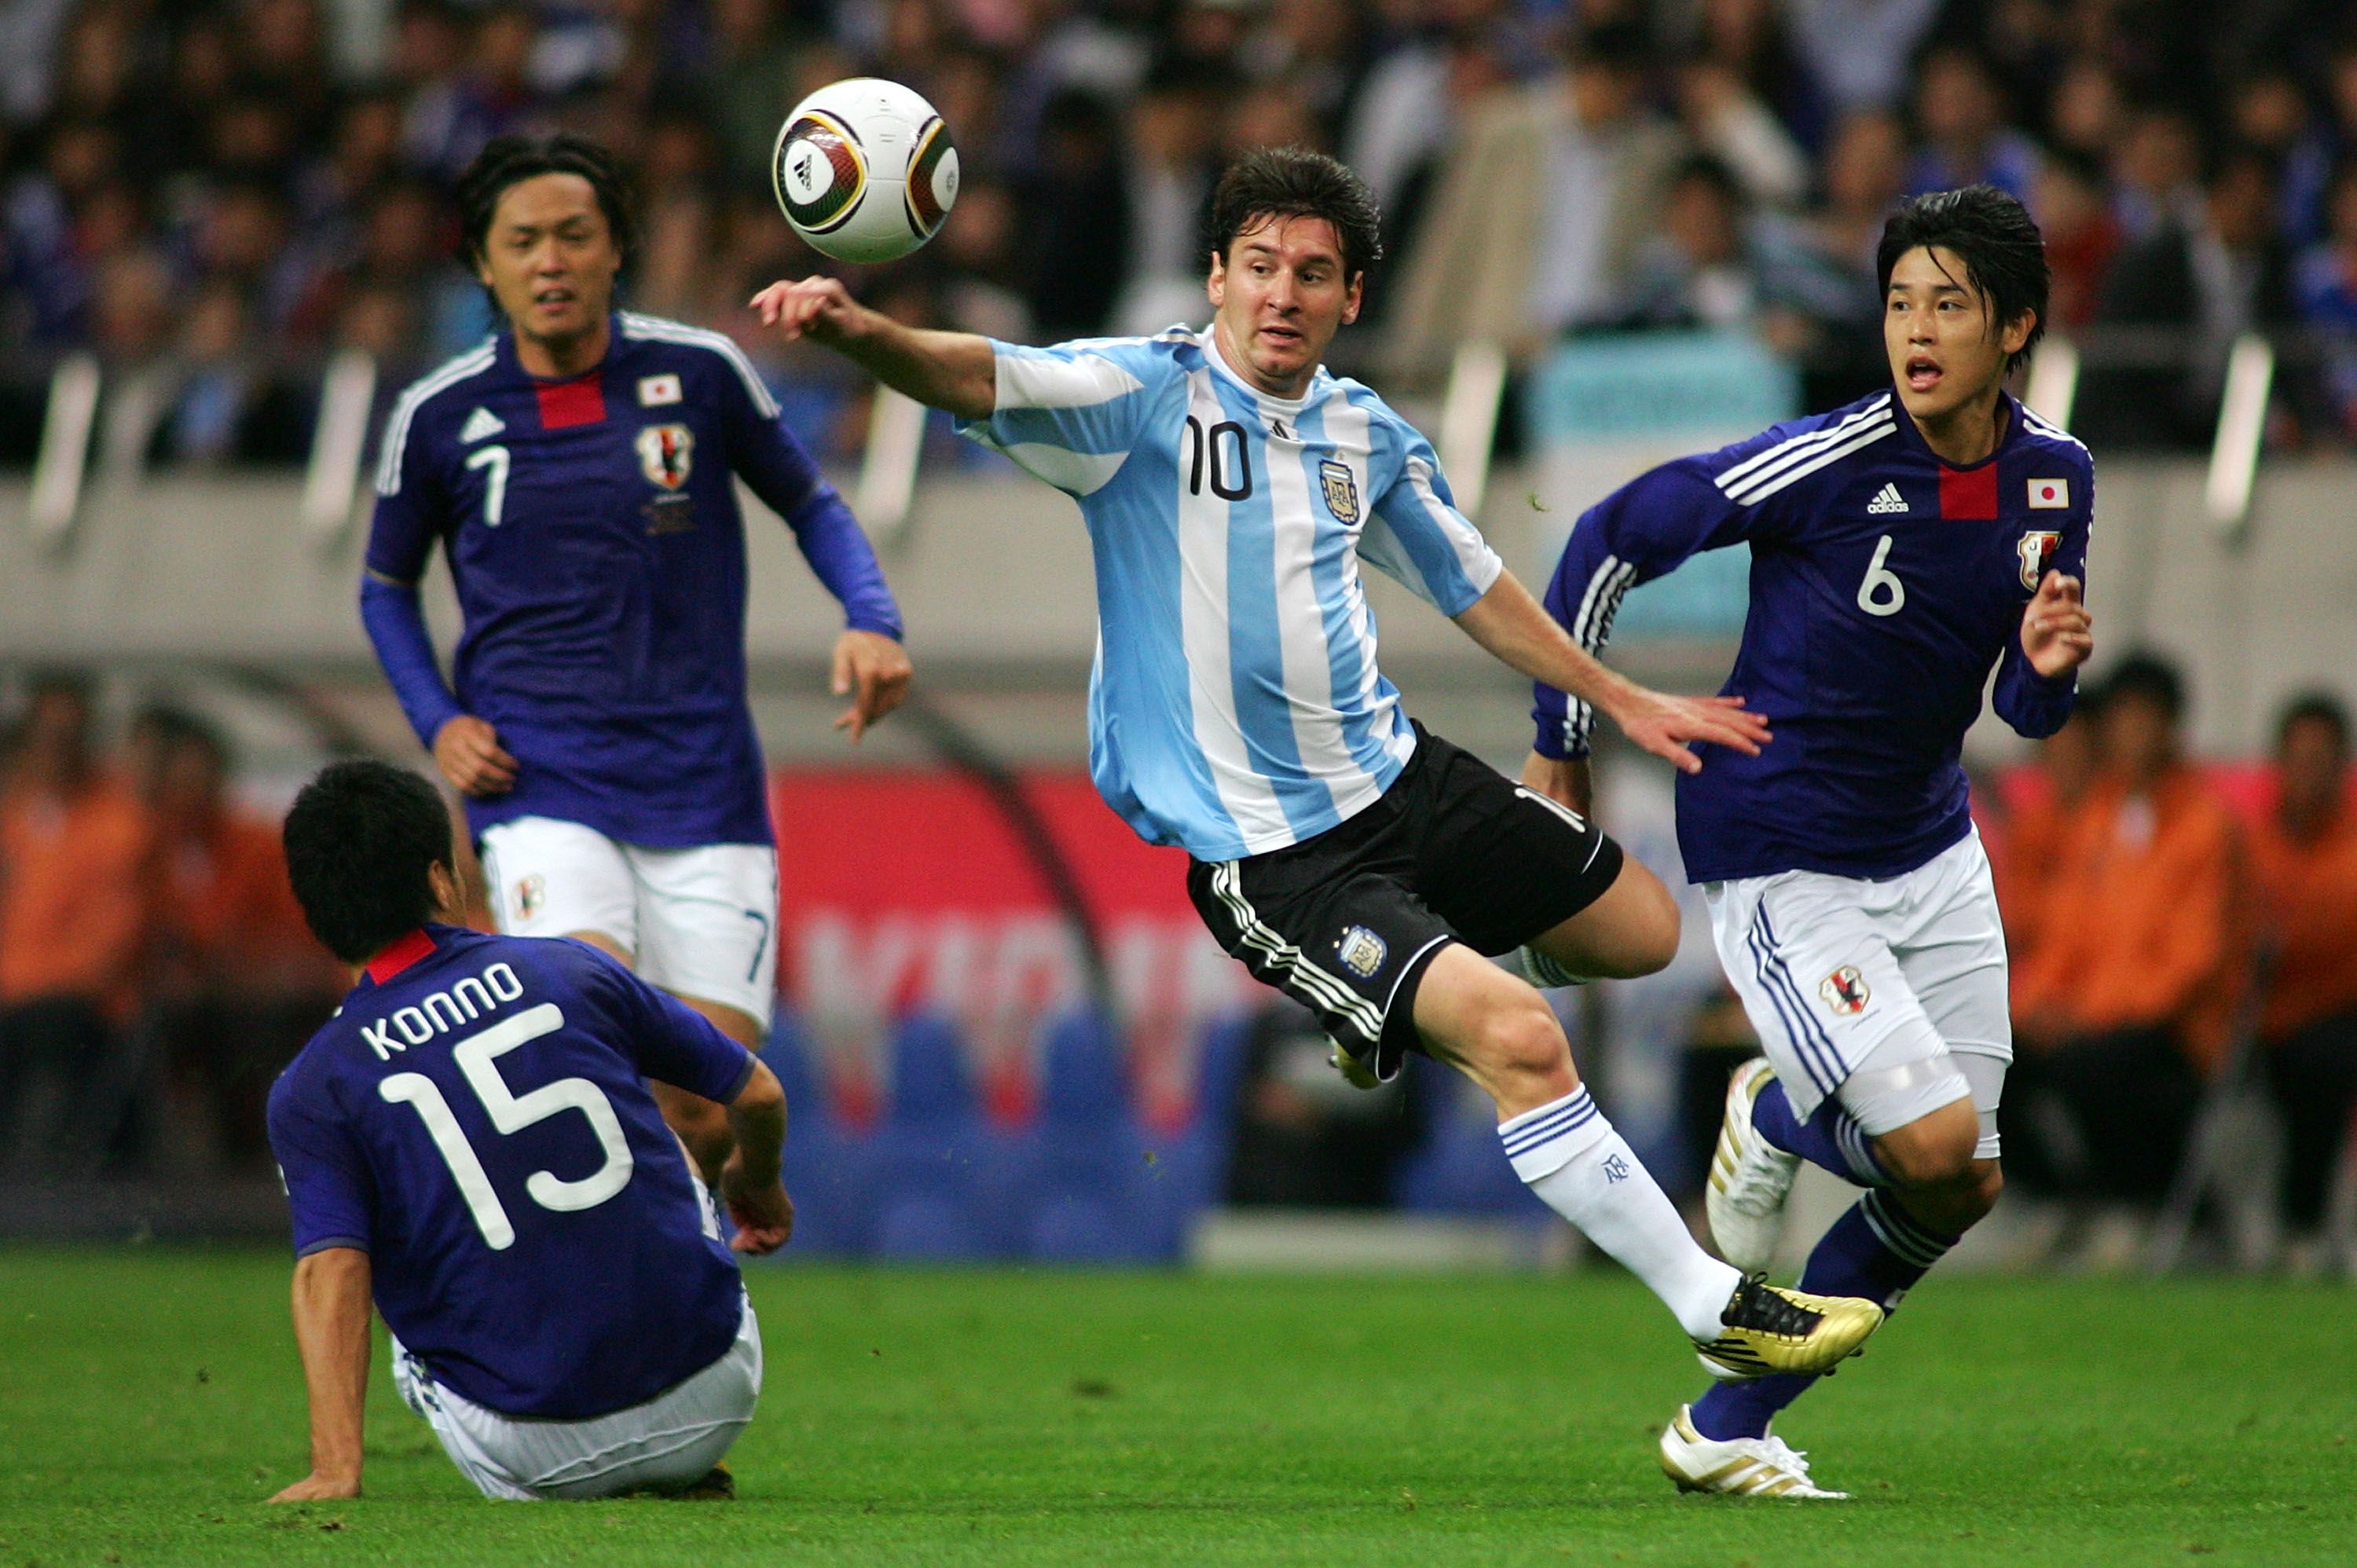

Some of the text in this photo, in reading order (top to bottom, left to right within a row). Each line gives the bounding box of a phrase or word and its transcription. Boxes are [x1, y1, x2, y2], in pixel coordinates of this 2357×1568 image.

[465, 445, 510, 527] 7
[1186, 415, 1252, 501] 10
[1867, 502, 1909, 514] adidas
[1857, 535, 1905, 617] 6
[745, 909, 770, 984] 7
[361, 962, 524, 1061] KONNO
[378, 1002, 635, 1251] 15
